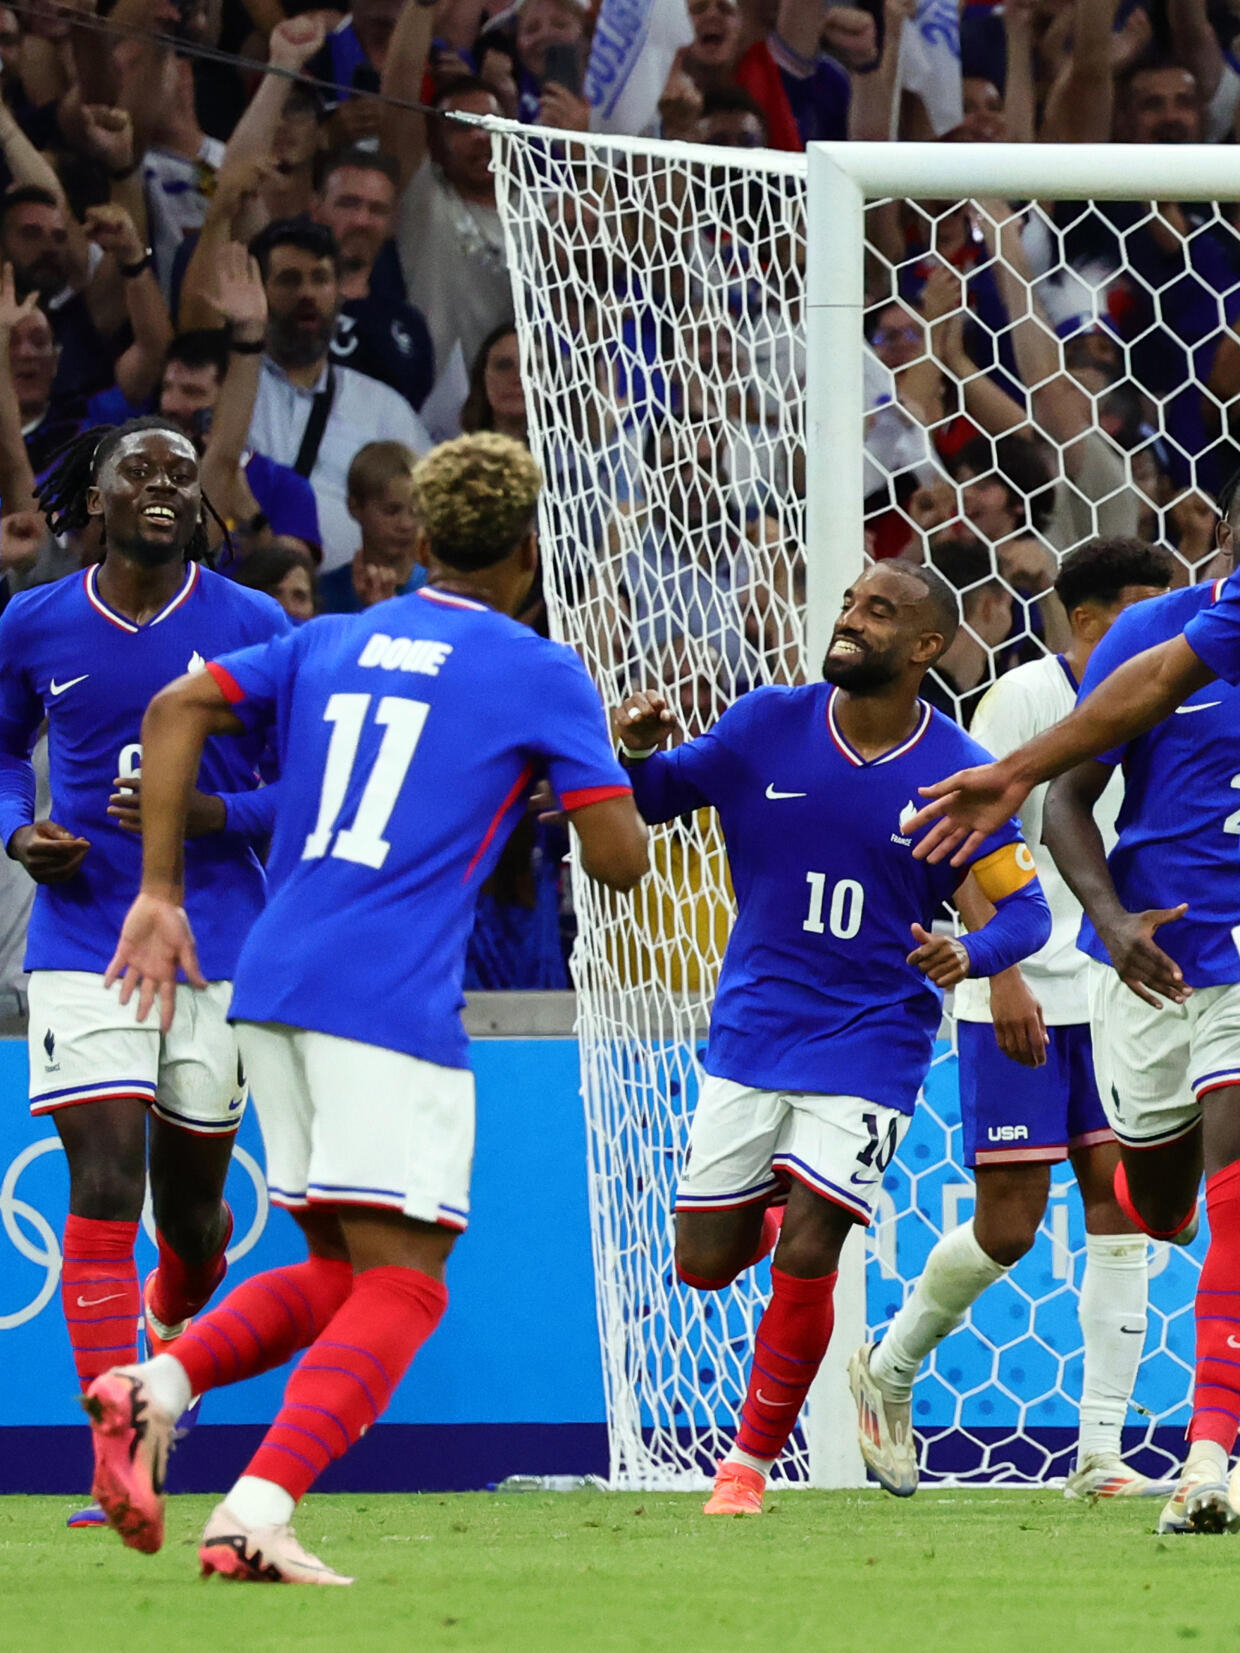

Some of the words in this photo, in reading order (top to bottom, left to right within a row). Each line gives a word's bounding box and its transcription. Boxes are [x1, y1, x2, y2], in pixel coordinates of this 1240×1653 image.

[301, 693, 430, 870] 11
[803, 871, 865, 939] 10
[856, 1113, 897, 1173] 10
[988, 1125, 1028, 1141] USA
